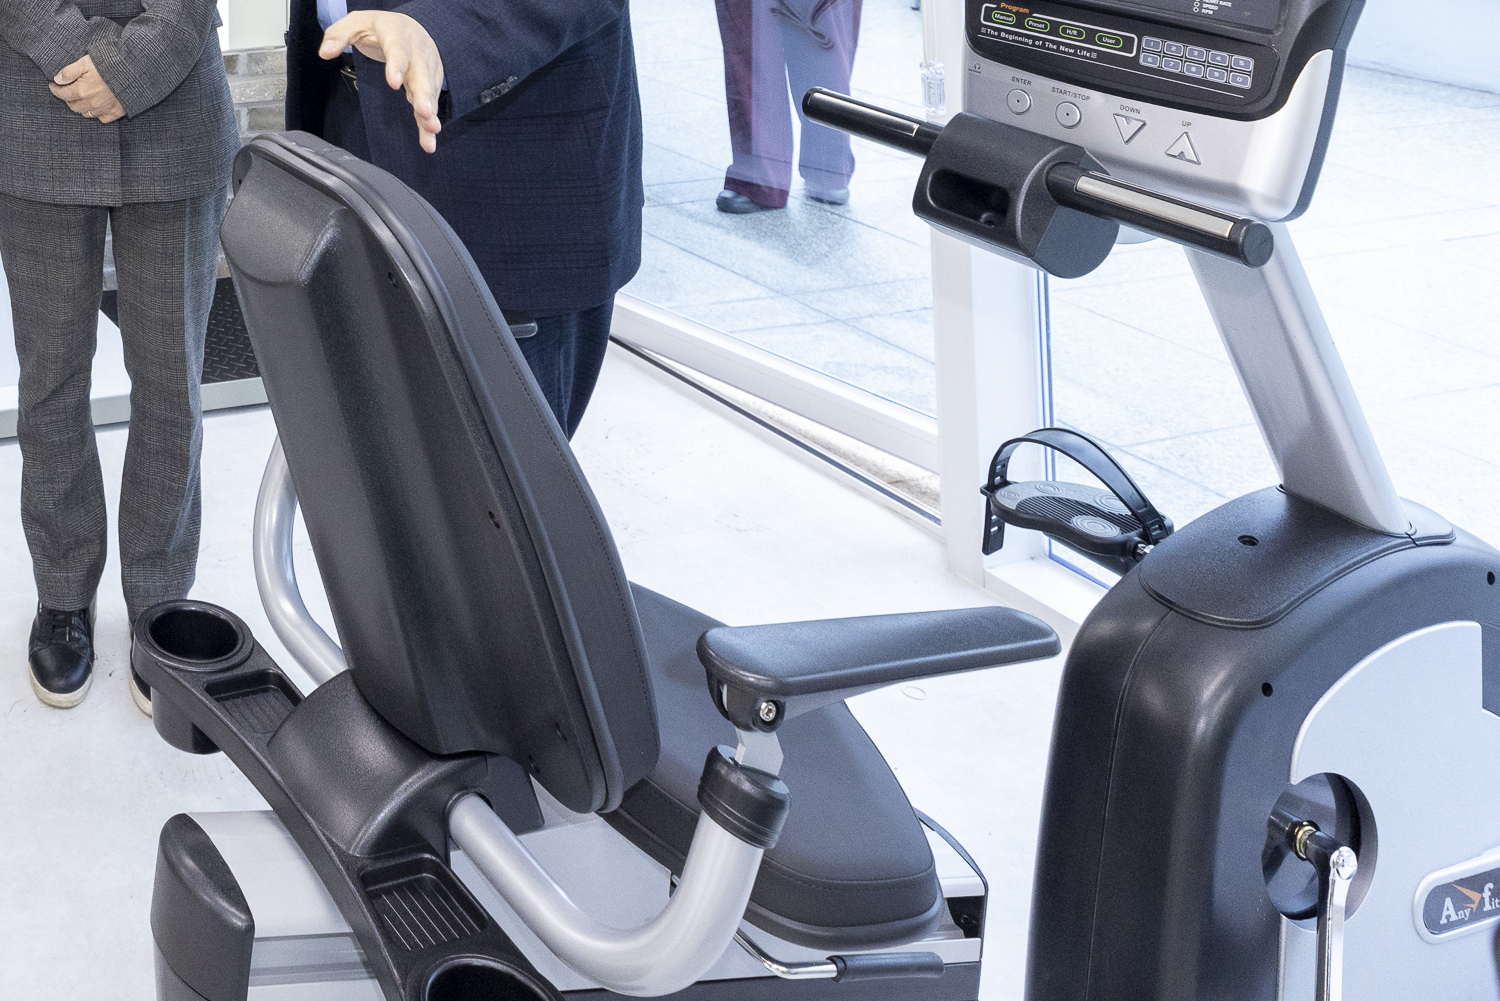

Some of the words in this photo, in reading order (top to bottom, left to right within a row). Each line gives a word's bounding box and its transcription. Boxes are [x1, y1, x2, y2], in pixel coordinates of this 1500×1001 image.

[1000, 2, 1029, 14] Program
[995, 13, 1013, 22] Manual
[1028, 21, 1045, 29] Preset
[987, 28, 998, 36] The
[1000, 31, 1033, 45] Beginning
[1045, 41, 1058, 50] The
[1059, 44, 1075, 54] New
[1077, 49, 1091, 57] Life
[1102, 36, 1116, 44] User
[1011, 76, 1032, 87] ENTER
[1051, 86, 1091, 102] START/STOP
[1119, 104, 1141, 114] DOWN
[1181, 120, 1192, 128] UP
